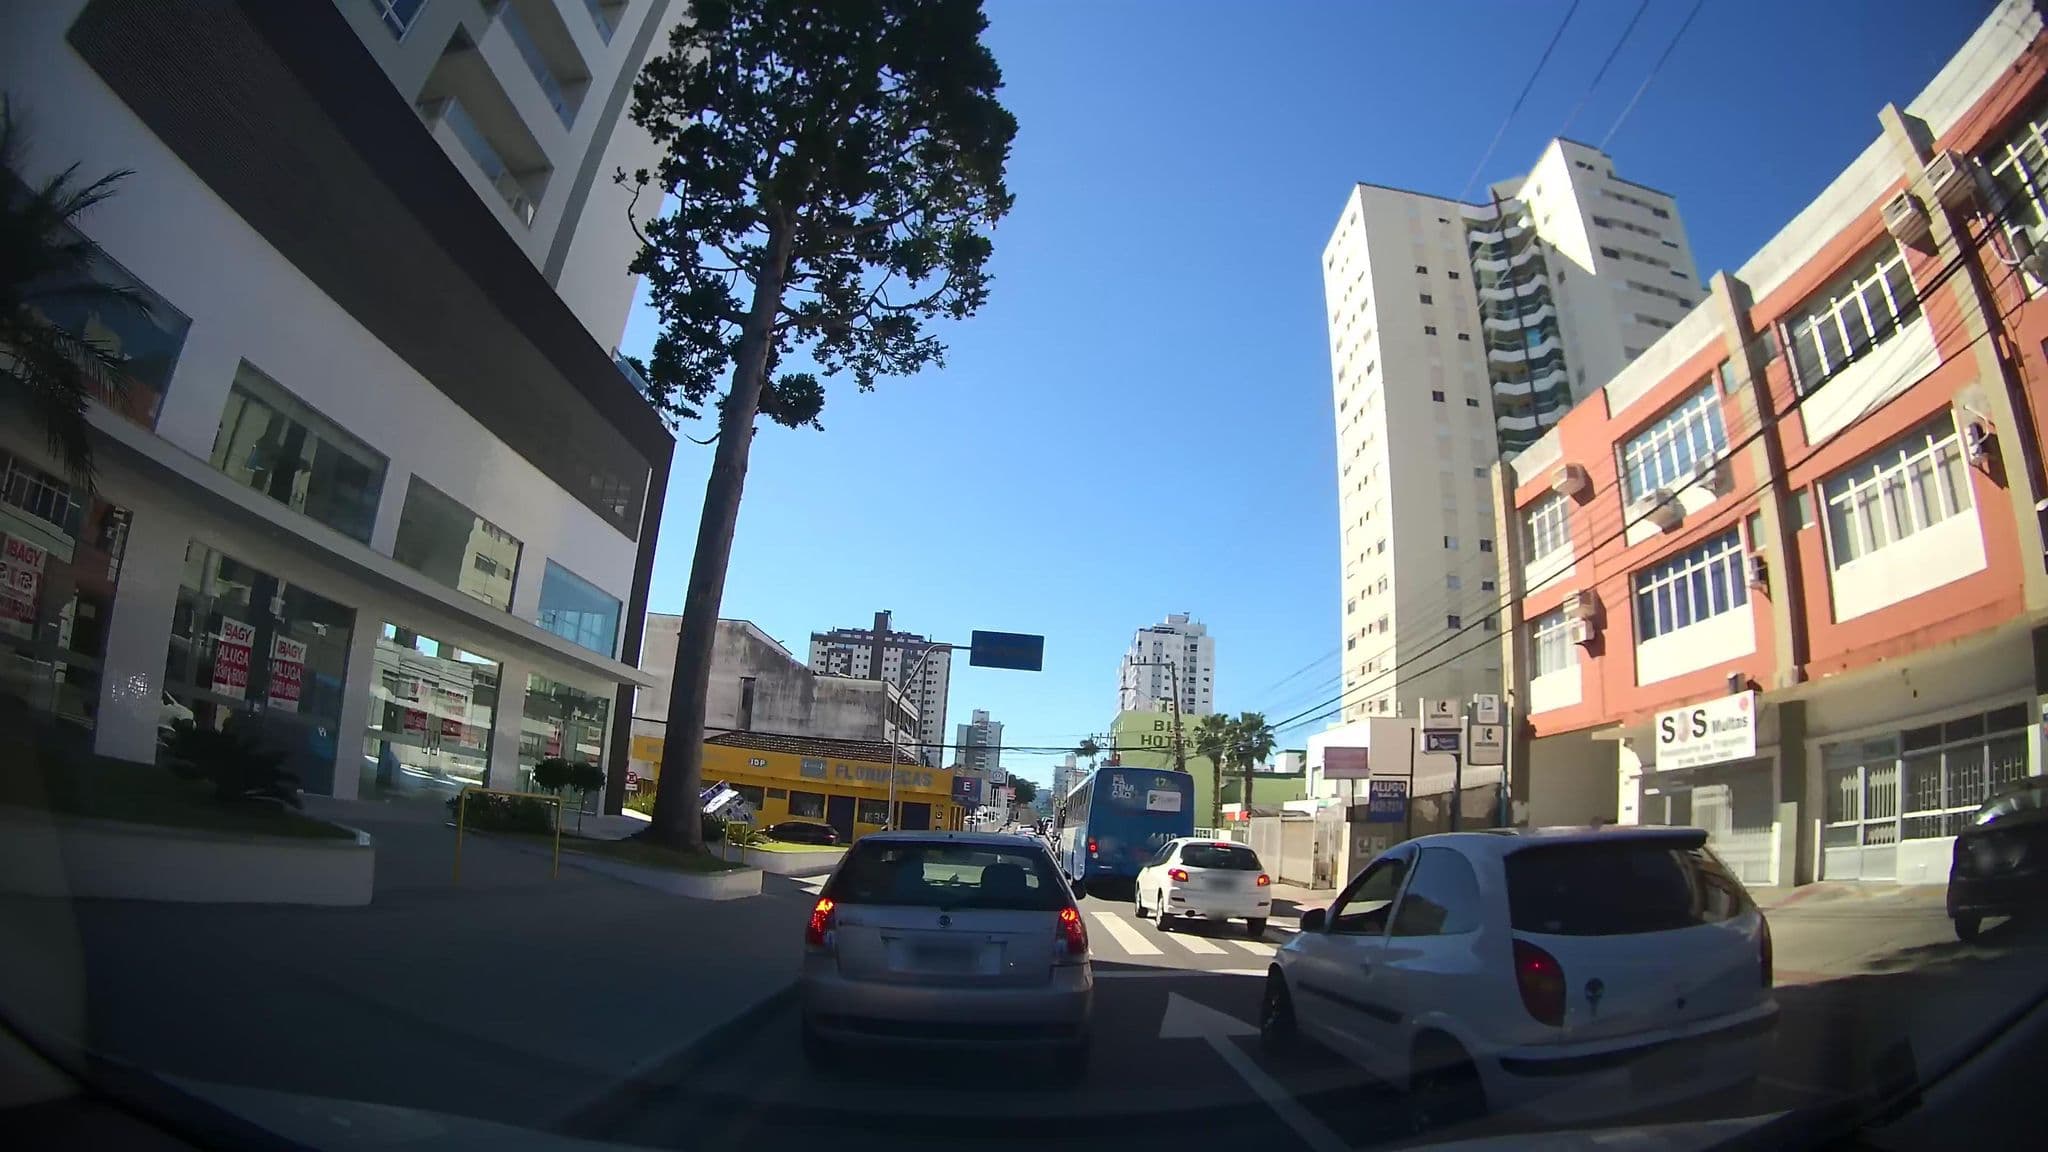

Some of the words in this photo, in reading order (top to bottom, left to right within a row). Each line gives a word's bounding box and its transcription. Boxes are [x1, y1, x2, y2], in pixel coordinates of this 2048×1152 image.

[217, 644, 249, 667] ALUGA
[272, 661, 301, 681] ALUGA
[1711, 716, 1749, 734] Multas
[1371, 781, 1406, 793] ALUGO
